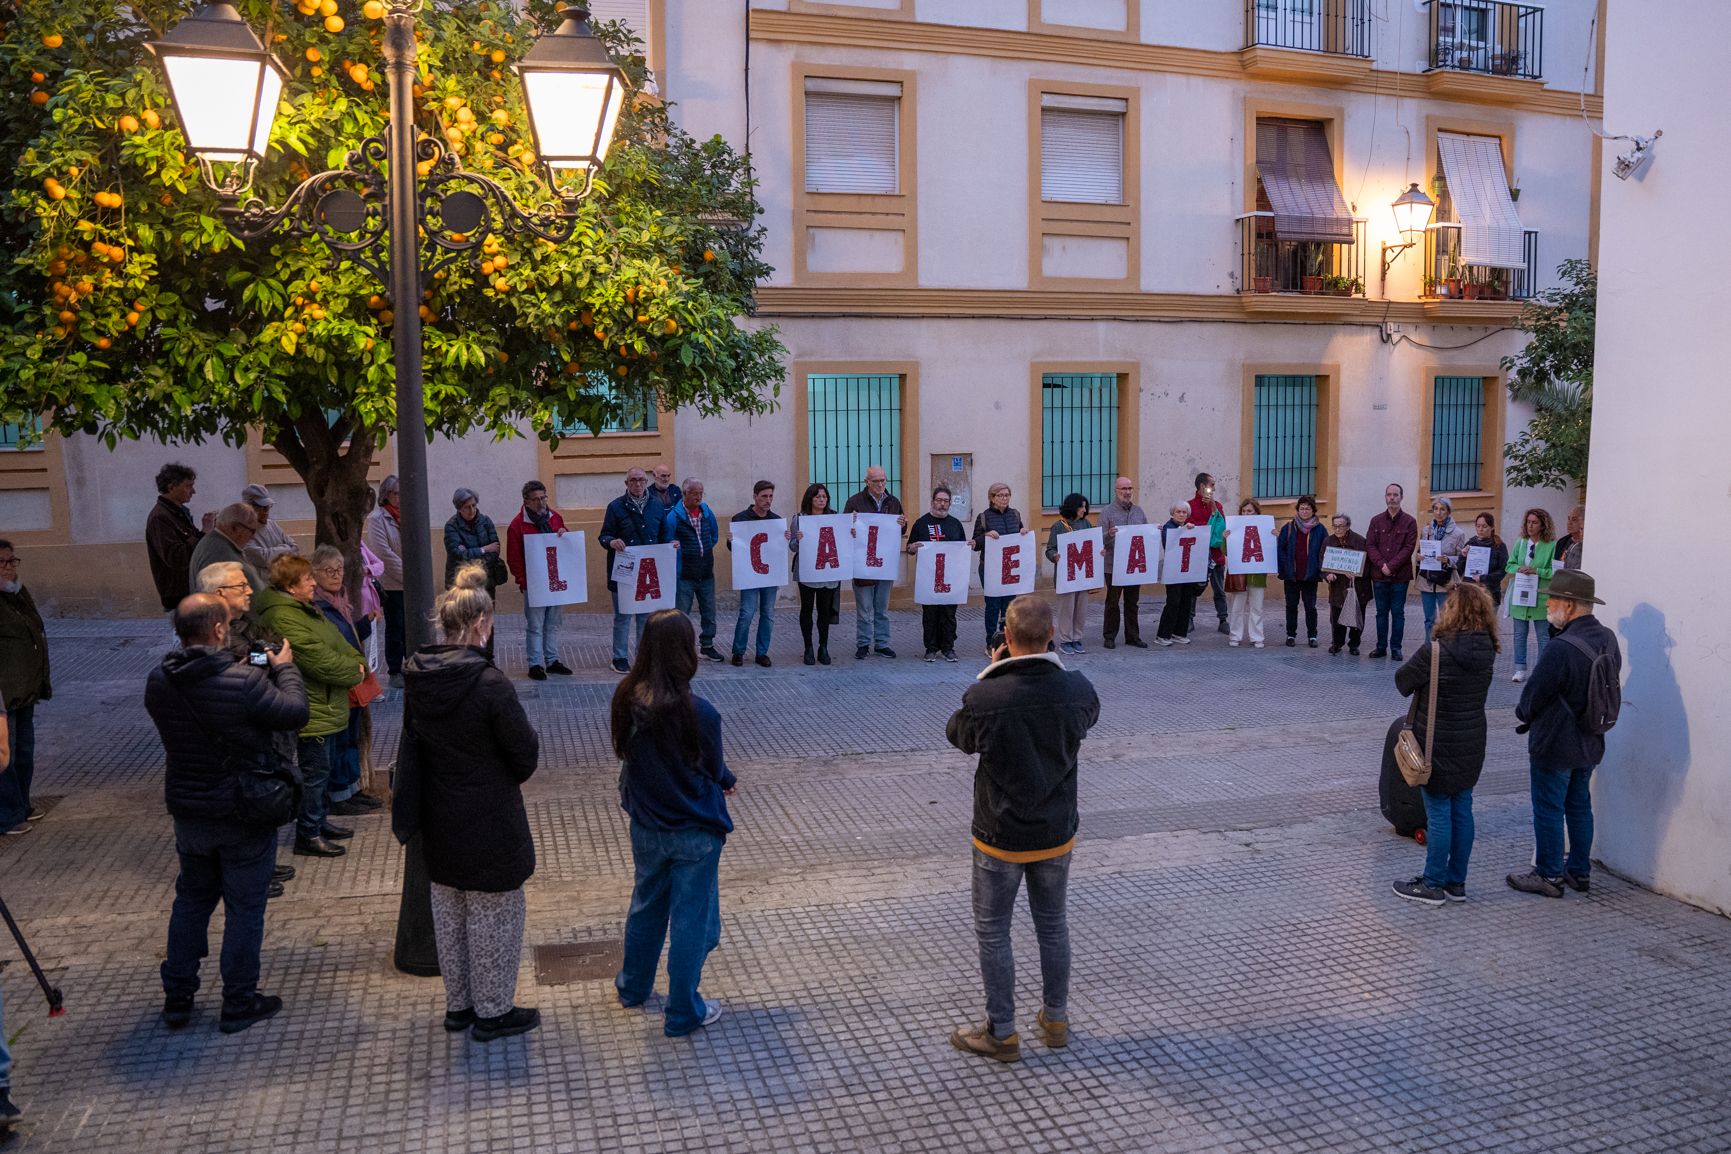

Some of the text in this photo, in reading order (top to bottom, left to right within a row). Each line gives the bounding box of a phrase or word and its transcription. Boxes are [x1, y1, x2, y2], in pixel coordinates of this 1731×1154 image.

[750, 532, 769, 574] C
[815, 526, 839, 570] A
[866, 525, 883, 567] L
[1067, 540, 1094, 581] M
[1126, 535, 1147, 574] A
[1179, 537, 1196, 572] T
[1241, 525, 1264, 562] A
[546, 546, 567, 592] L
[635, 558, 661, 601] A
[934, 553, 951, 593] L
[1001, 545, 1020, 585] E
